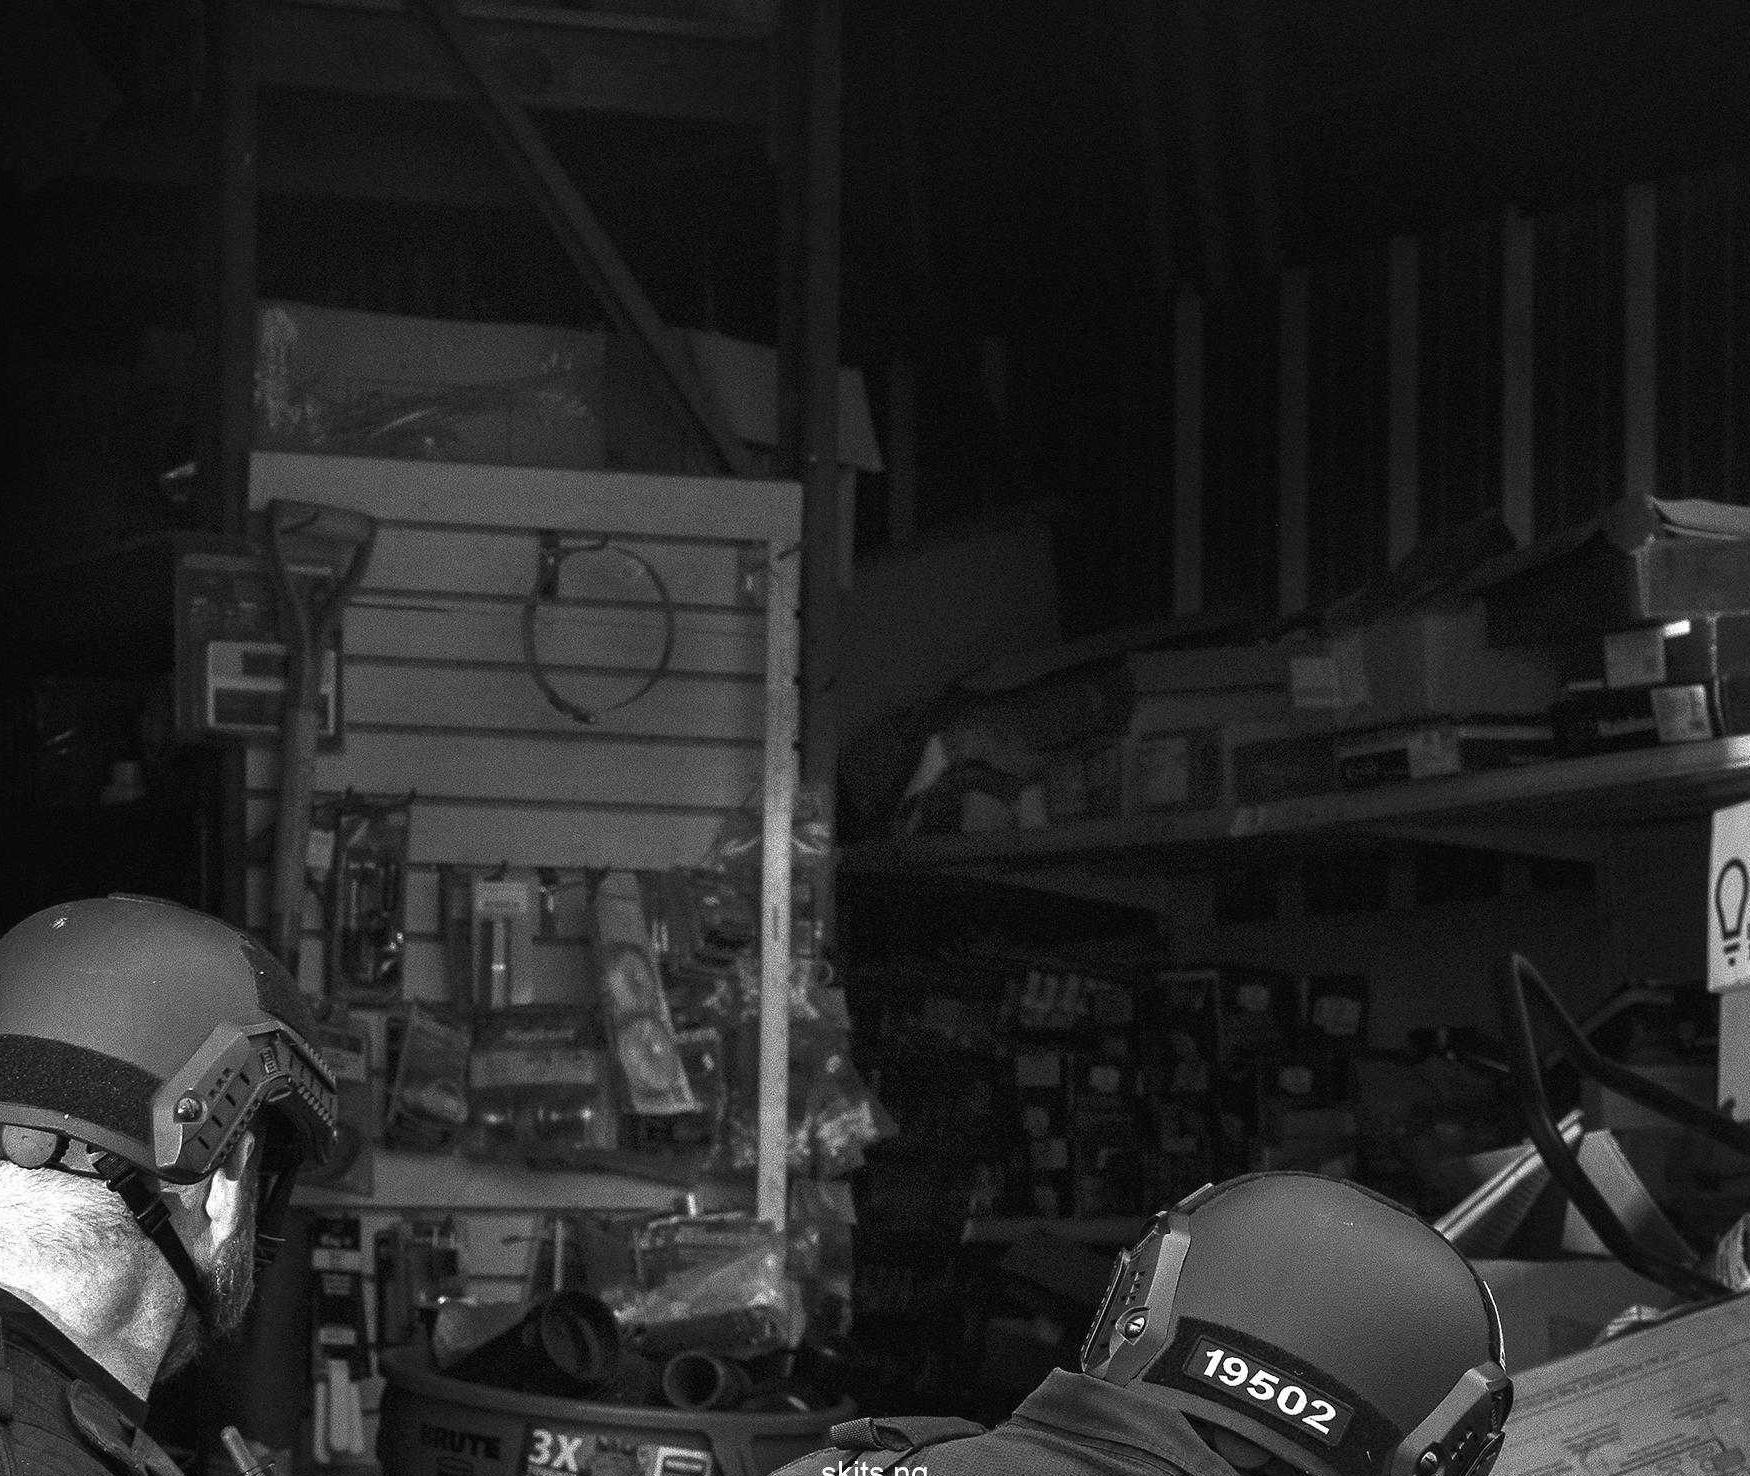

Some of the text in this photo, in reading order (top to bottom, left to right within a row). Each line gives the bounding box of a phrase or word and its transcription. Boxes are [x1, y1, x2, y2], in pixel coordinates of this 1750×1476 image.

[1204, 1347, 1338, 1436] 19502
[419, 1423, 501, 1460] BRUTE
[528, 1428, 583, 1473] 3X
